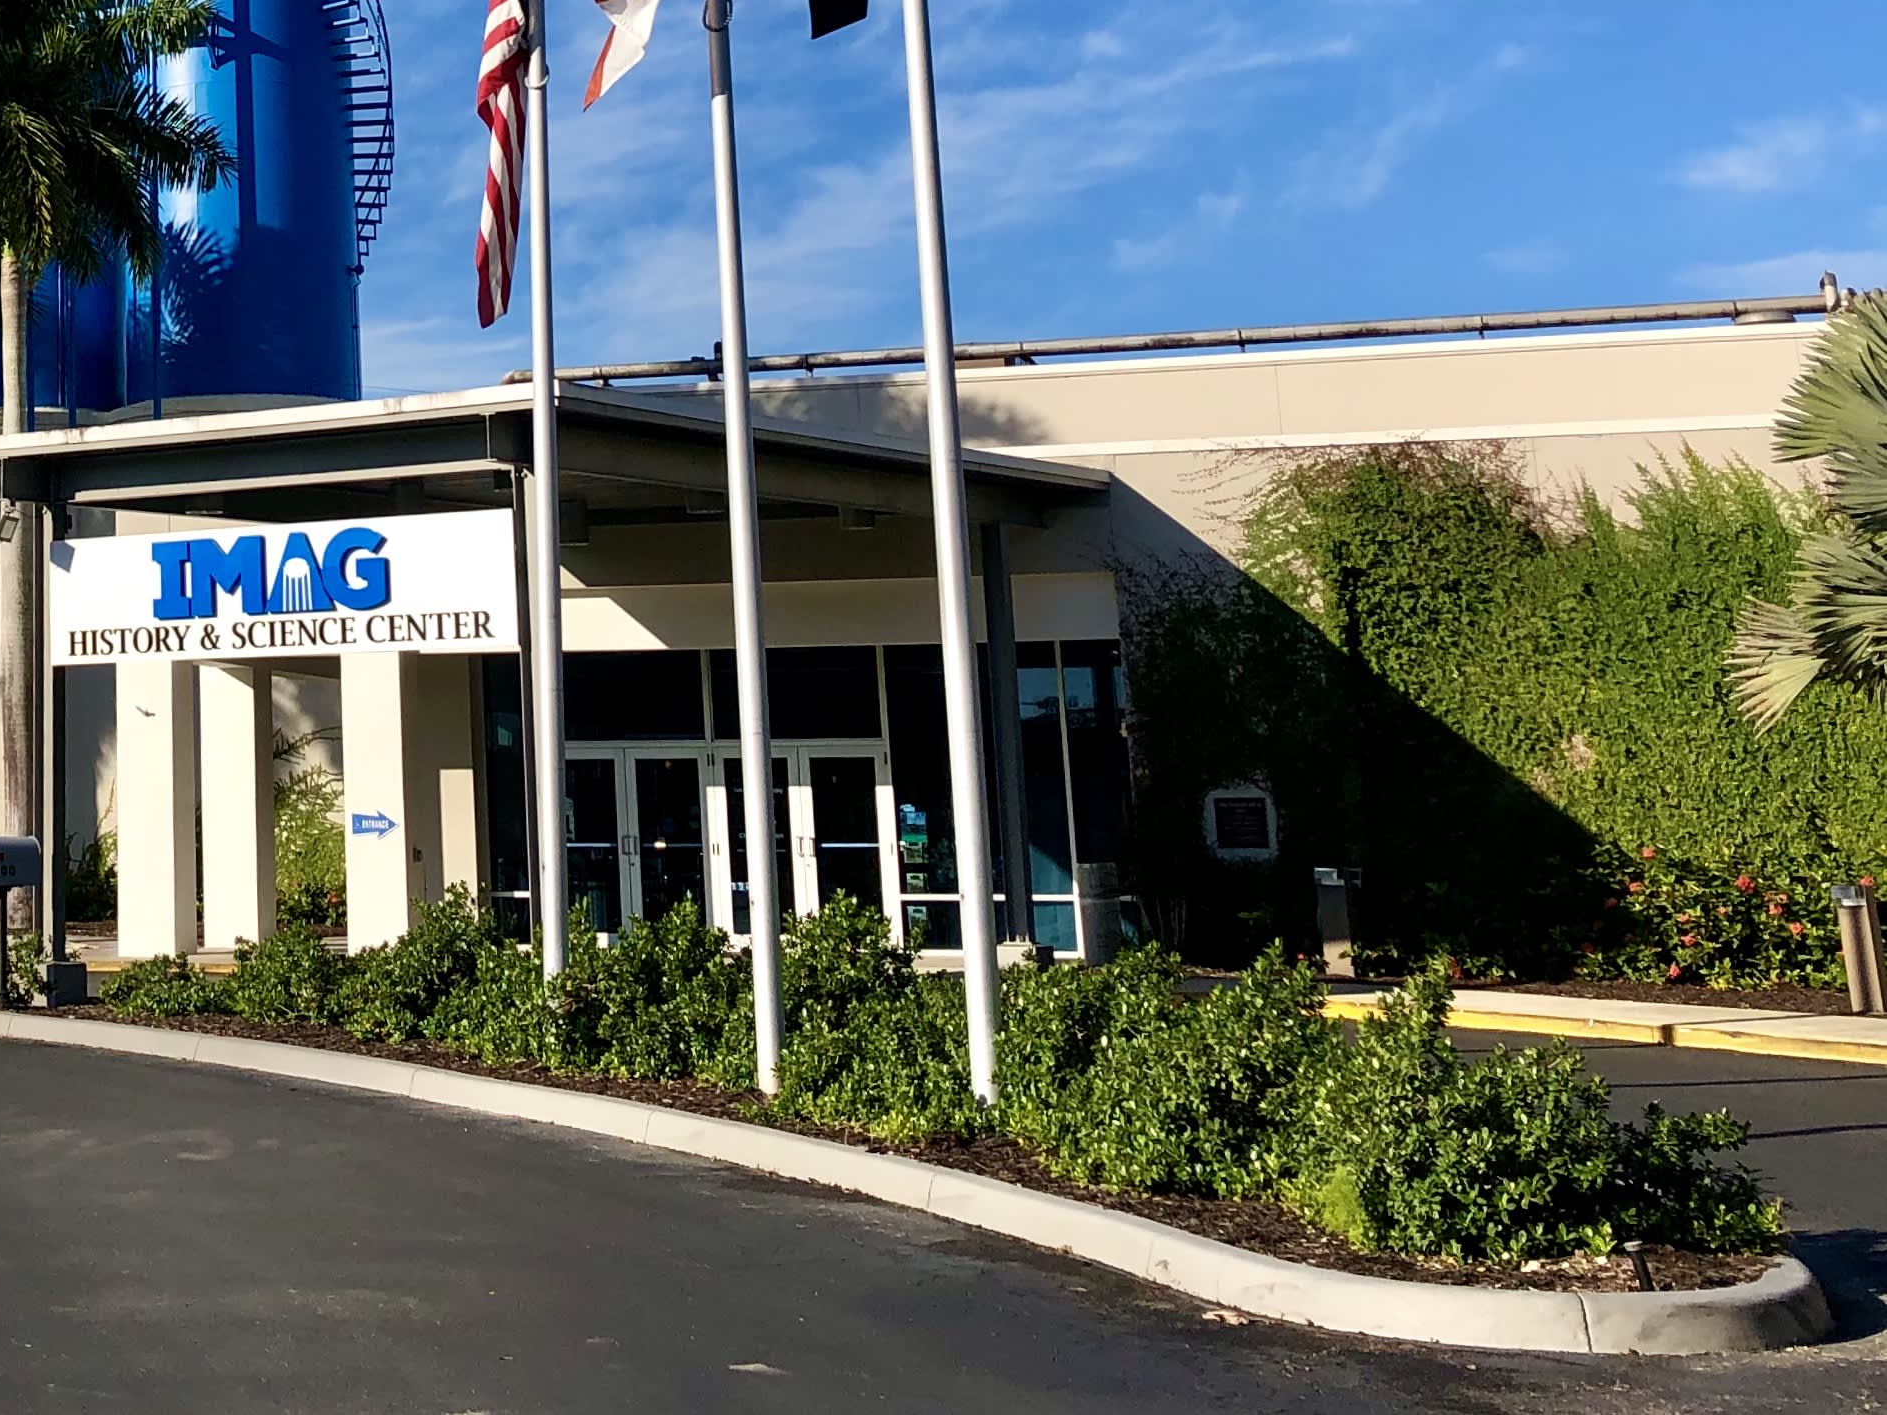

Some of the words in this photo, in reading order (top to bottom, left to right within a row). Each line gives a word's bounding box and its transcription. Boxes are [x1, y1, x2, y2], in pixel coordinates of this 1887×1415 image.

[151, 527, 391, 620] IMAG
[68, 625, 190, 657] HISTORY
[200, 623, 221, 650] &
[232, 617, 356, 649] SCIENCE
[366, 611, 495, 644] CENTER
